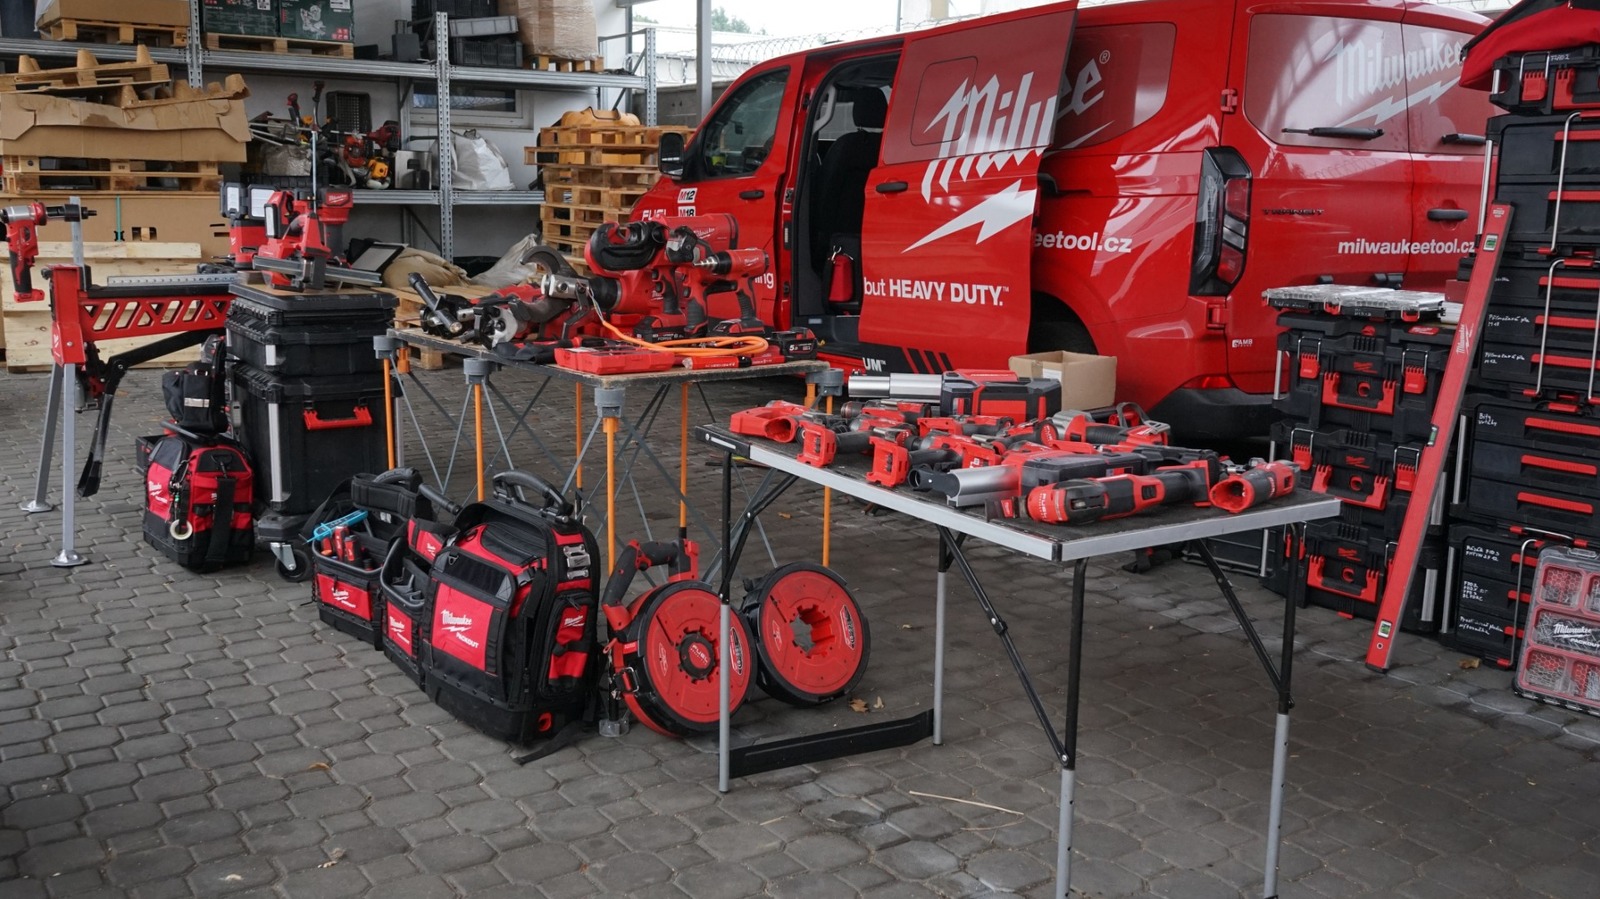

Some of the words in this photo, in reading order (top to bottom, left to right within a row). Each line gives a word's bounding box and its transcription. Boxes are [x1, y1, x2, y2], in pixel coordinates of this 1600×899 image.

[679, 190, 696, 201] M12
[679, 208, 695, 218] M18
[1262, 208, 1324, 216] TRANSIT
[1338, 238, 1475, 255] milwaukeetool.cz
[864, 277, 886, 297] but
[889, 279, 945, 301] HEAVY
[441, 609, 473, 625] Milwaukee
[1553, 623, 1592, 634] Milwaukee
[455, 632, 479, 648] PACKOUT
